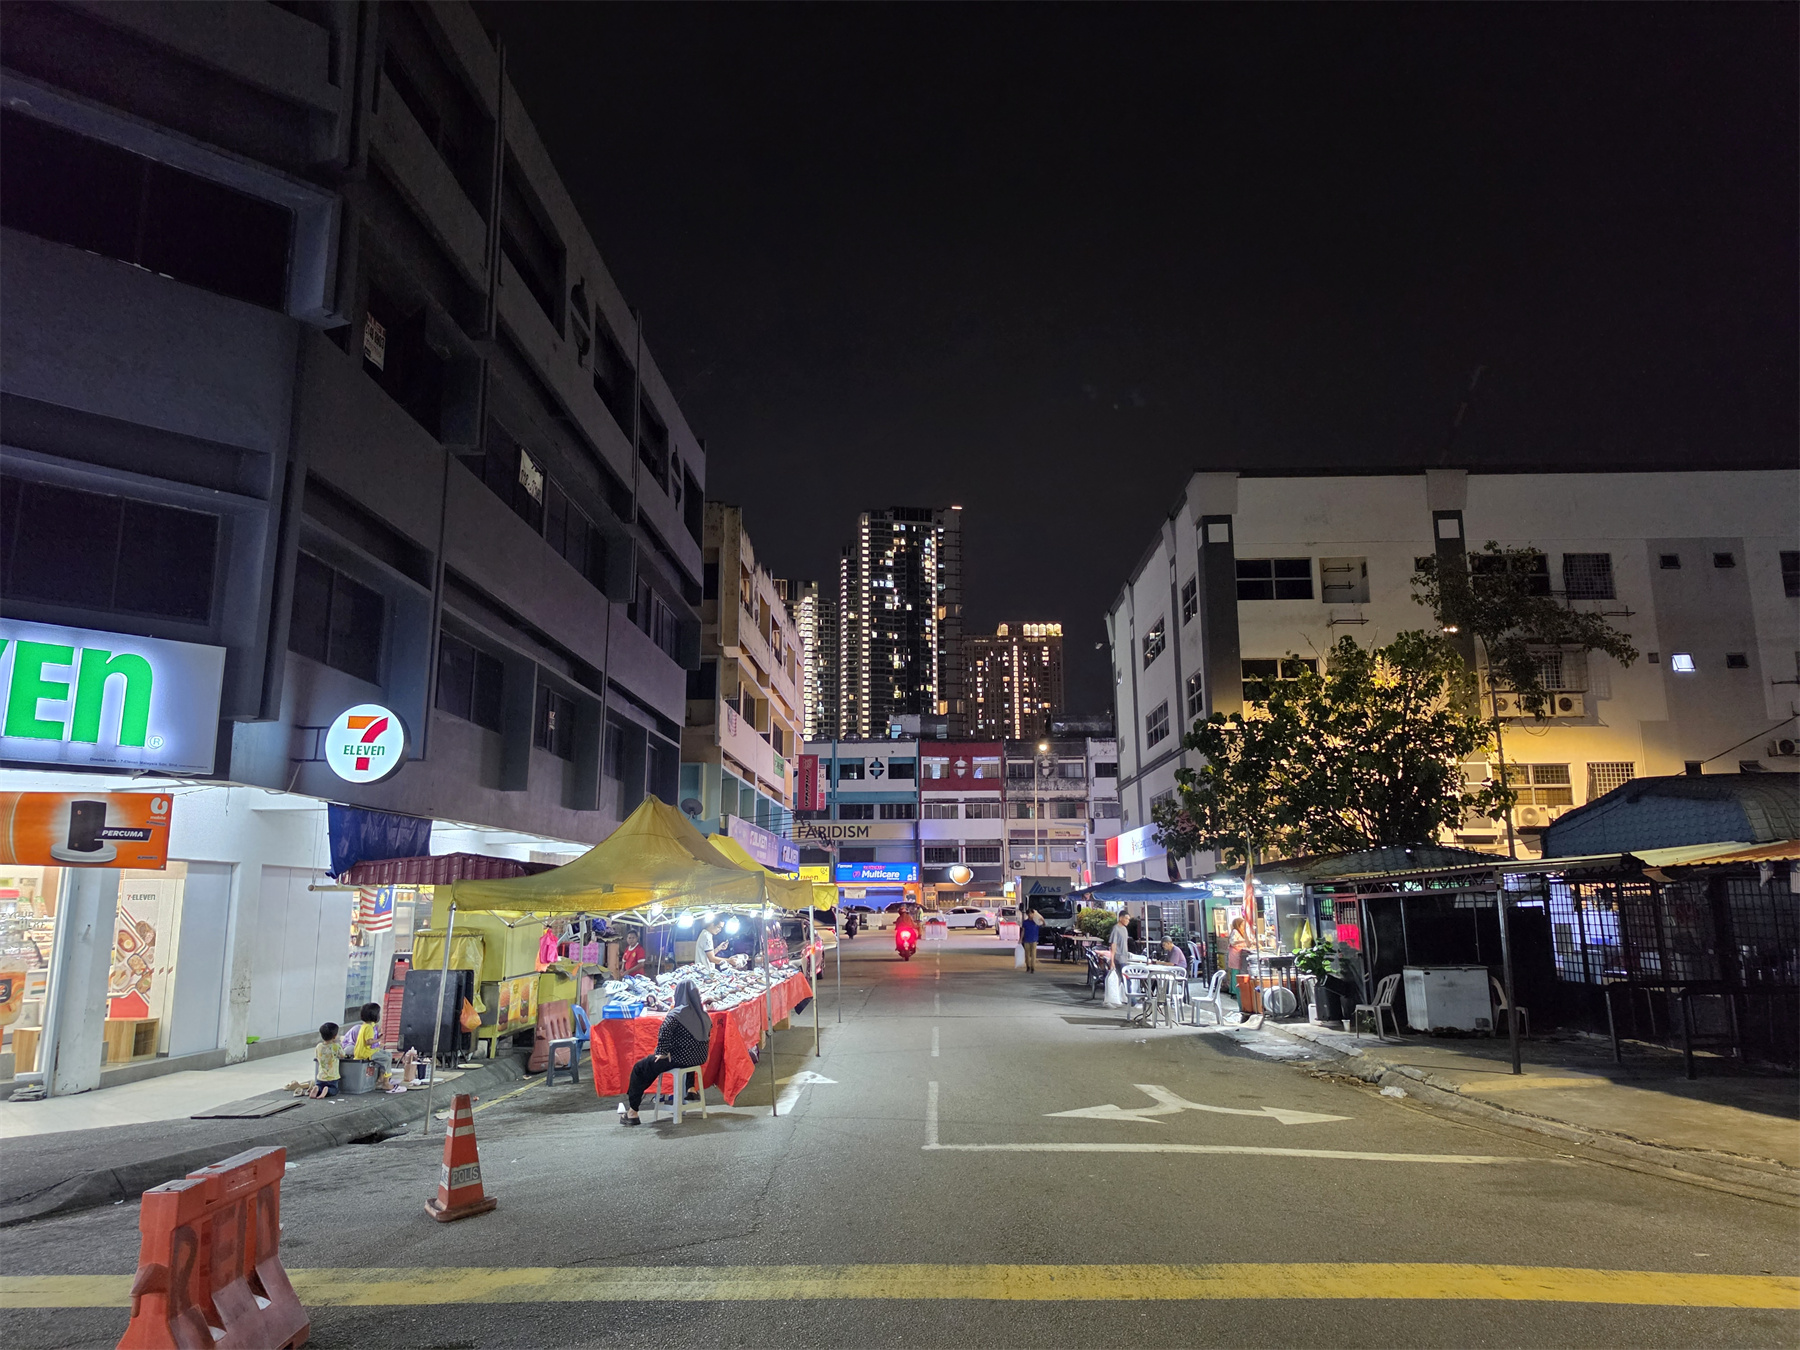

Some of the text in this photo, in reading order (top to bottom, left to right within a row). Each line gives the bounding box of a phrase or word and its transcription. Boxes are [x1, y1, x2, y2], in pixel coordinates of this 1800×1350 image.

[101, 829, 143, 838] PERCUMA
[797, 825, 869, 839] FARIDISM
[861, 870, 900, 879] Multicare
[453, 1167, 480, 1182] POLIS
